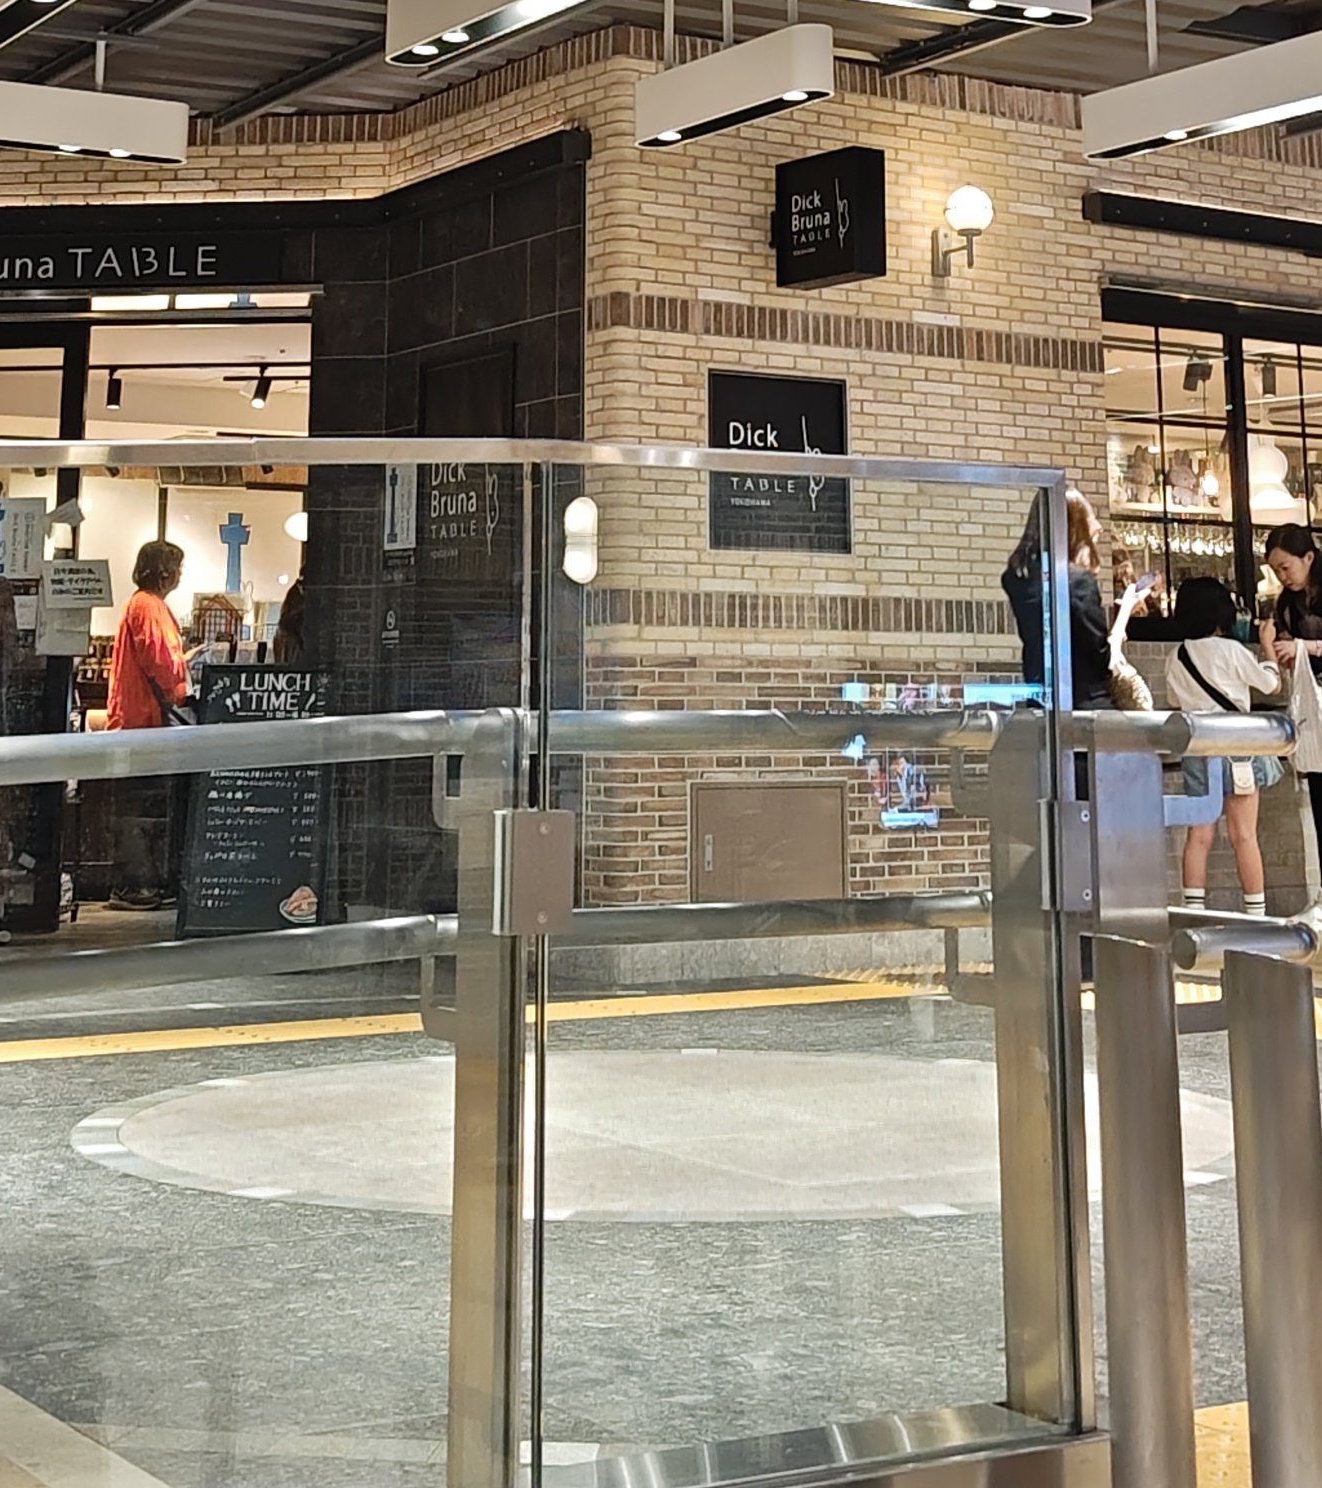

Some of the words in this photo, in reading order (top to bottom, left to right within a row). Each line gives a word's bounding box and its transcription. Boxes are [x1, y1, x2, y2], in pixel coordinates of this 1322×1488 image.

[791, 190, 822, 213] Dick
[791, 212, 831, 232] Bruna
[68, 245, 218, 279] TABLE
[729, 421, 779, 448] Dick
[730, 476, 796, 493] TABLE
[430, 490, 477, 518] Bruna
[240, 672, 311, 691] LUNCH
[247, 691, 300, 711] TIME
